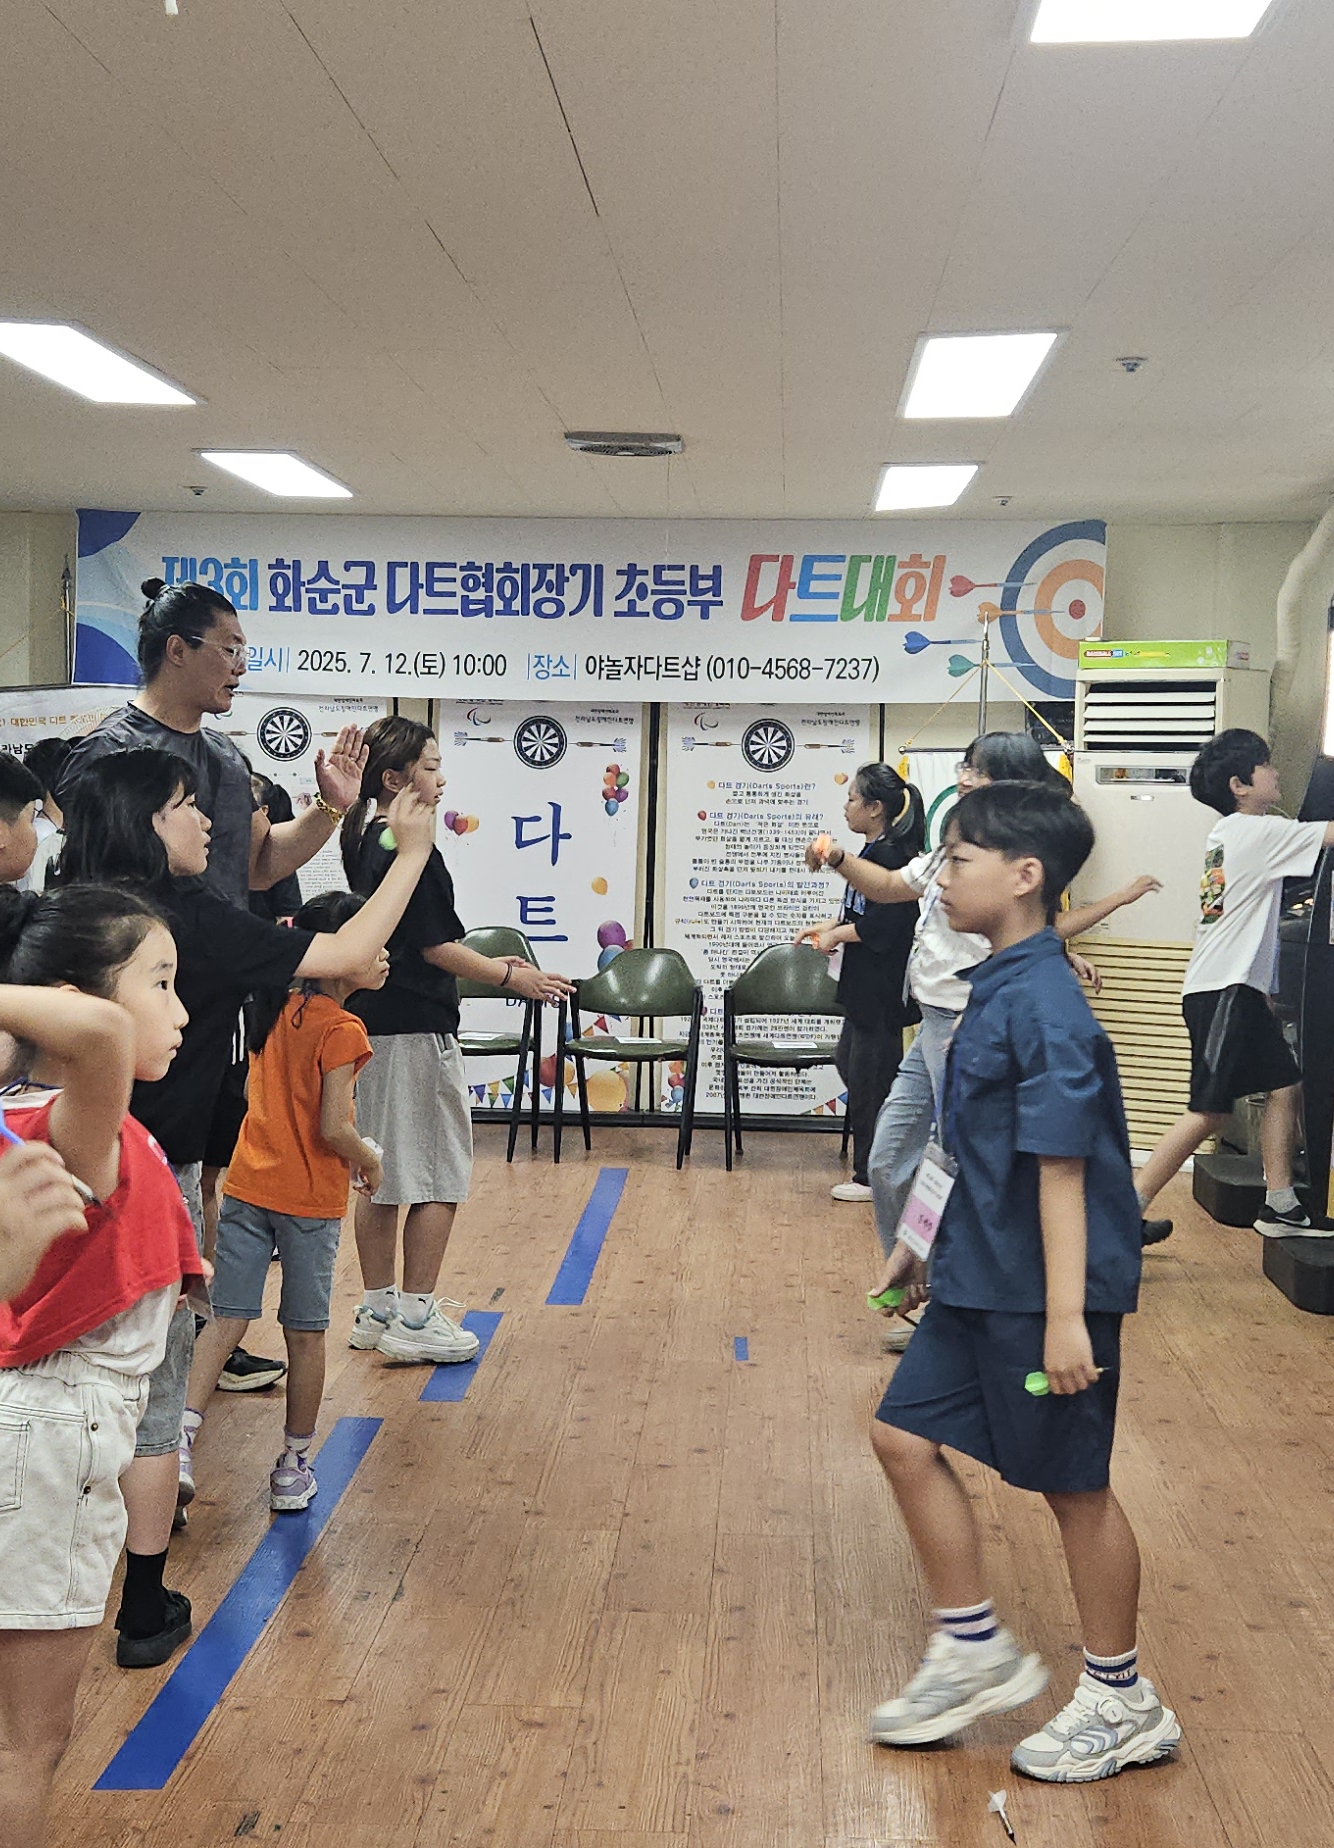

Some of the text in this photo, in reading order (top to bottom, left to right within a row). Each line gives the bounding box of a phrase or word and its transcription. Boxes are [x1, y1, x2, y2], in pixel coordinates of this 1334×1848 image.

[268, 557, 377, 617] 화순군
[387, 560, 604, 620] 다트협회장기
[614, 562, 723, 622] 초등부
[741, 553, 947, 622] 다트대회
[298, 649, 351, 674] 2025.
[360, 651, 376, 676] 7.
[386, 649, 447, 680] 12.(토)
[453, 653, 508, 678] 10:00
[532, 653, 571, 680] 장소
[585, 655, 702, 682] 야놀자다트샵
[706, 656, 880, 683] (010-4568-7237)
[511, 801, 572, 941] 다트
